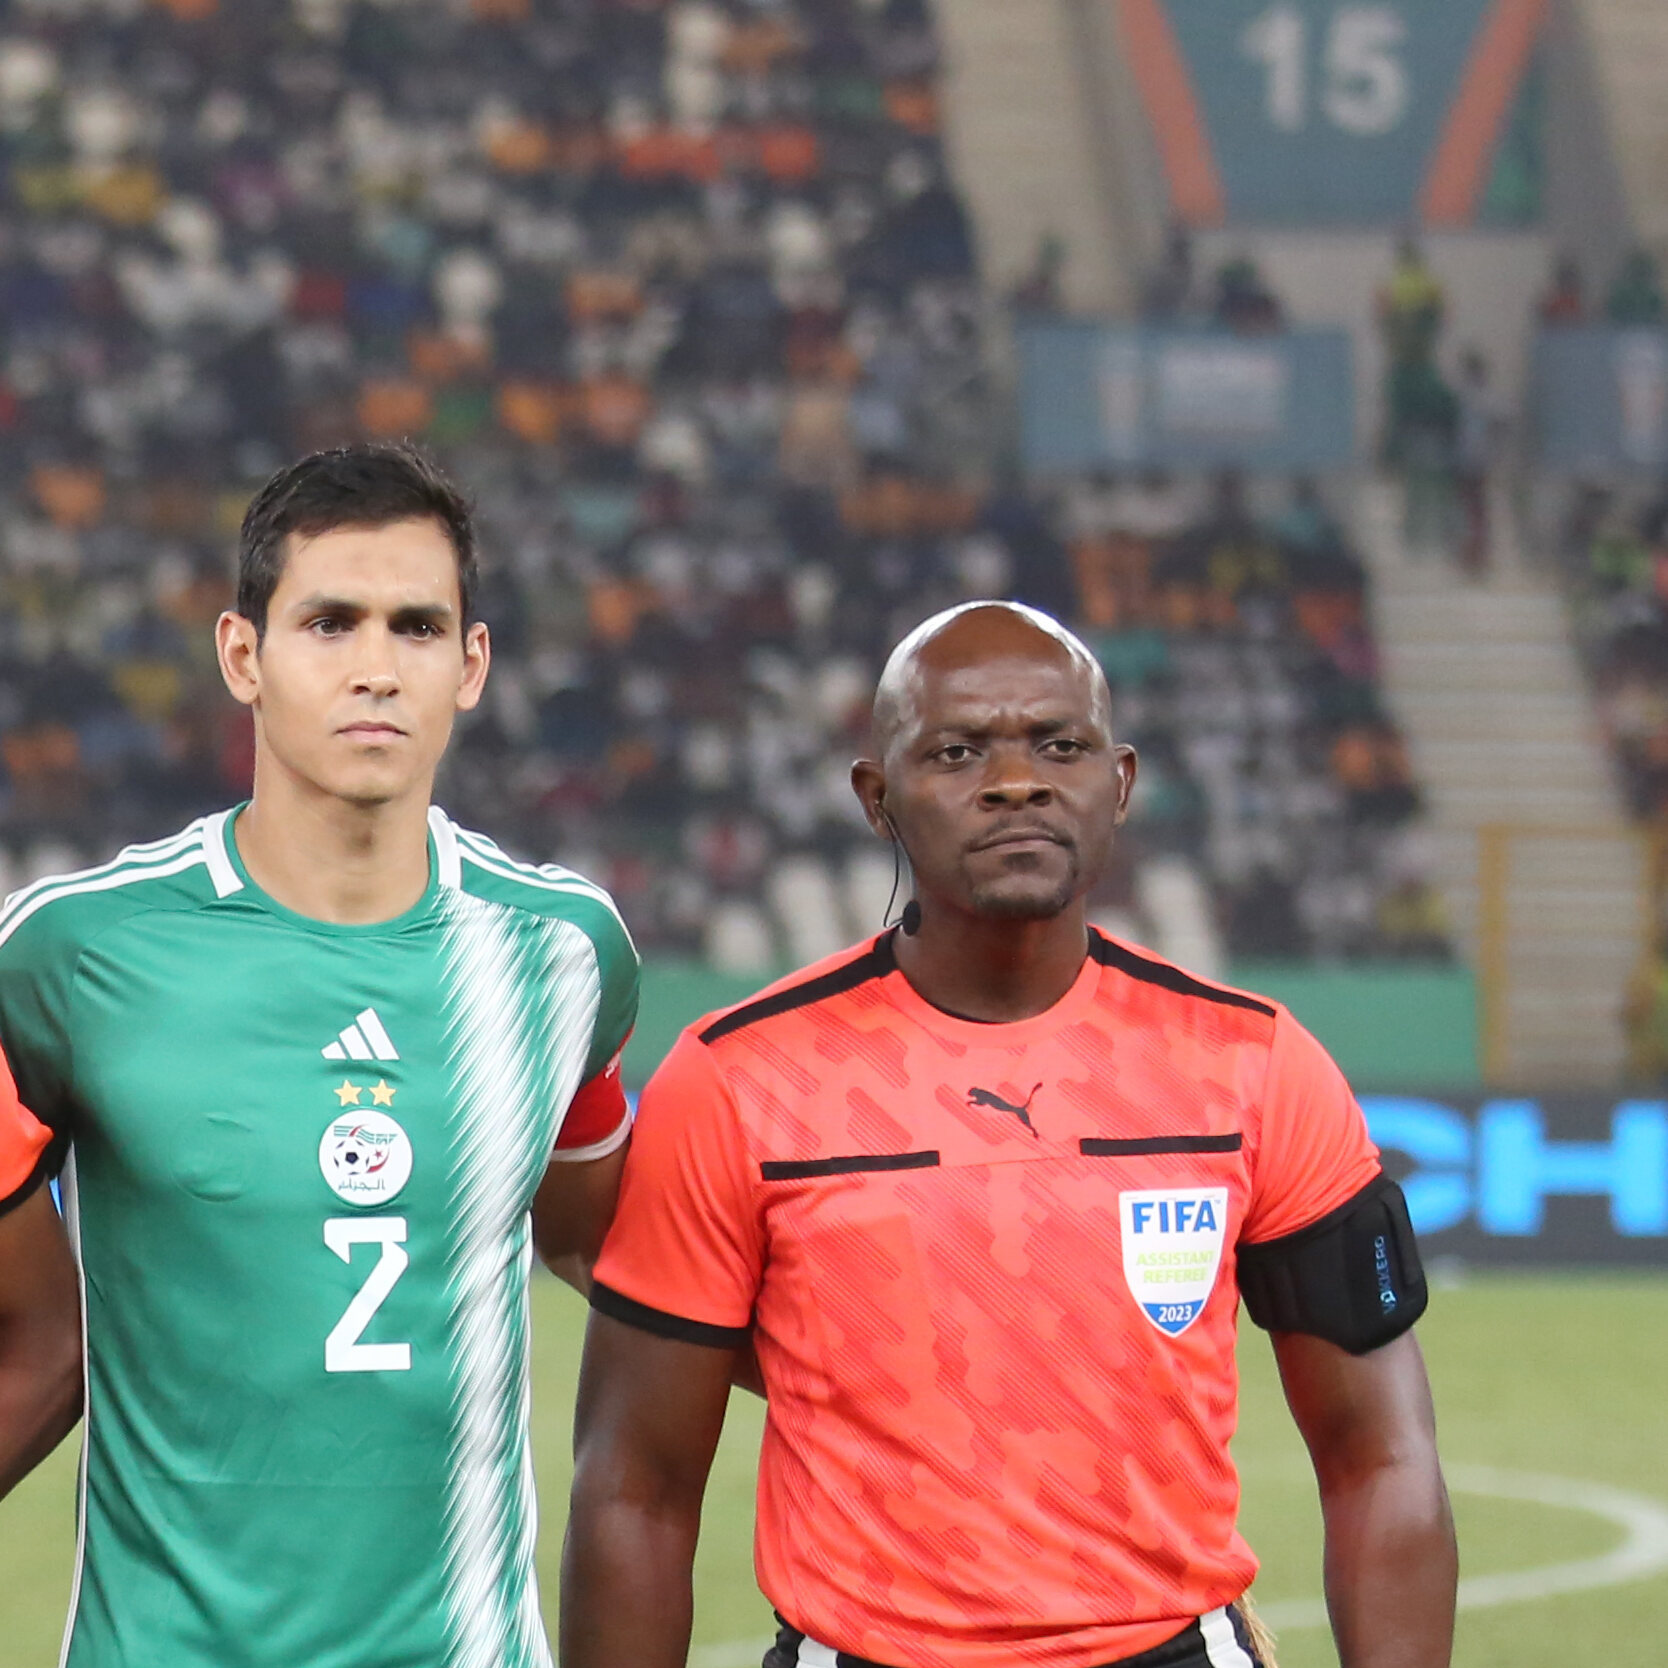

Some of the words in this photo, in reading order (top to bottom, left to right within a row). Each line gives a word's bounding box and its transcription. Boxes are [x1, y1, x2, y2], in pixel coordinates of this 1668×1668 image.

[1241, 6, 1407, 133] 15
[1131, 1200, 1217, 1234] FIFA
[1135, 1251, 1215, 1267] ASSISTANT
[323, 1216, 412, 1373] 2
[1157, 1304, 1193, 1323] 2023
